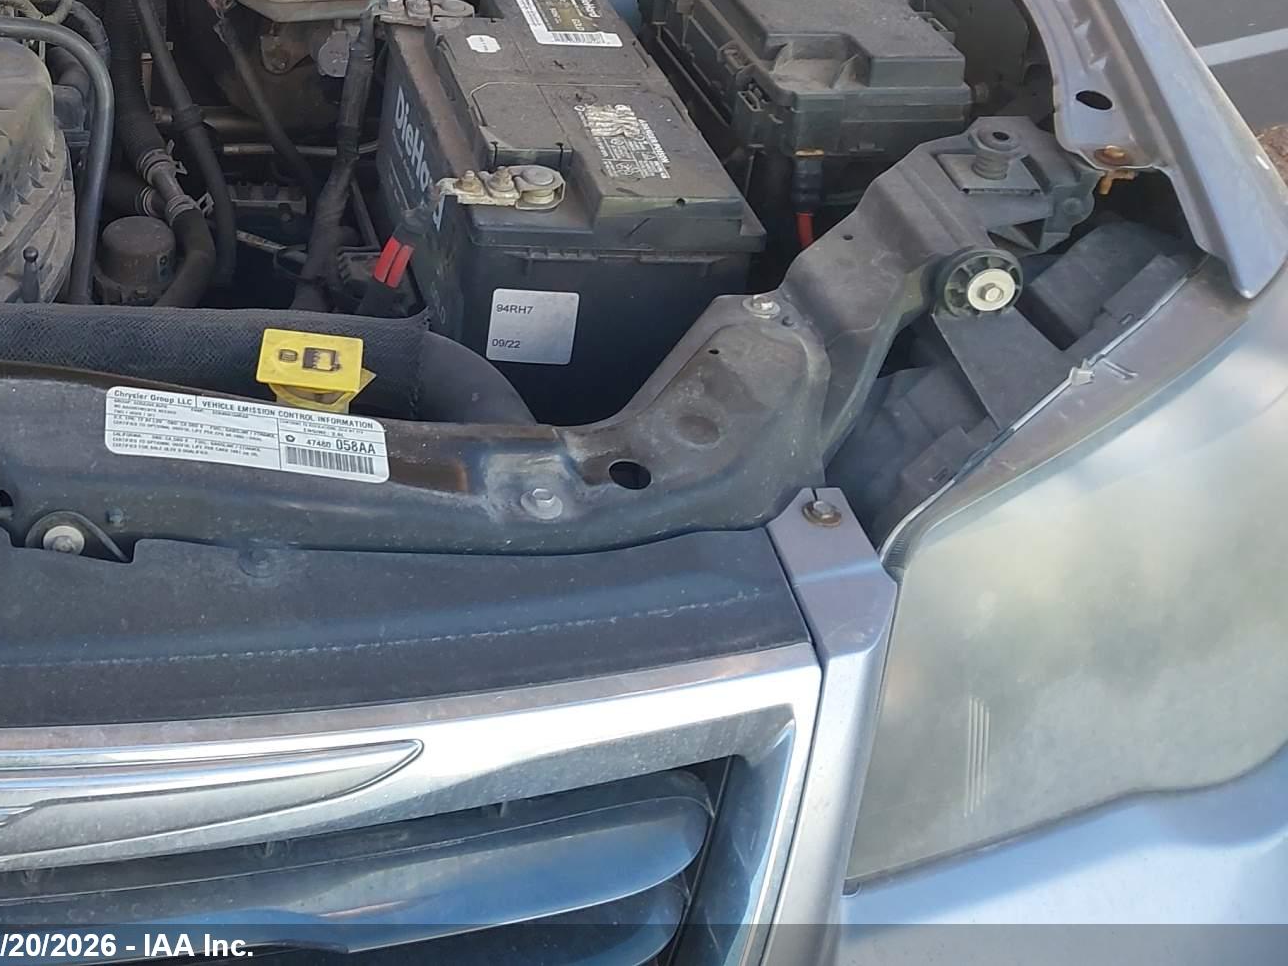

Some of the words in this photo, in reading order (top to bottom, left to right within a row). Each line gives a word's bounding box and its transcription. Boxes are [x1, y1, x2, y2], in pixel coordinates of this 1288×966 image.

[495, 303, 534, 315] 94RH7
[491, 338, 521, 349] 09/22
[113, 389, 148, 401] Chrysler
[150, 394, 176, 405] Group
[177, 397, 193, 406] LLC
[202, 401, 234, 412] VEHICLE
[237, 405, 276, 417] EMISSION
[278, 410, 314, 422] CONTROL
[317, 416, 373, 430] INFORMATION
[335, 438, 376, 455] 058AA
